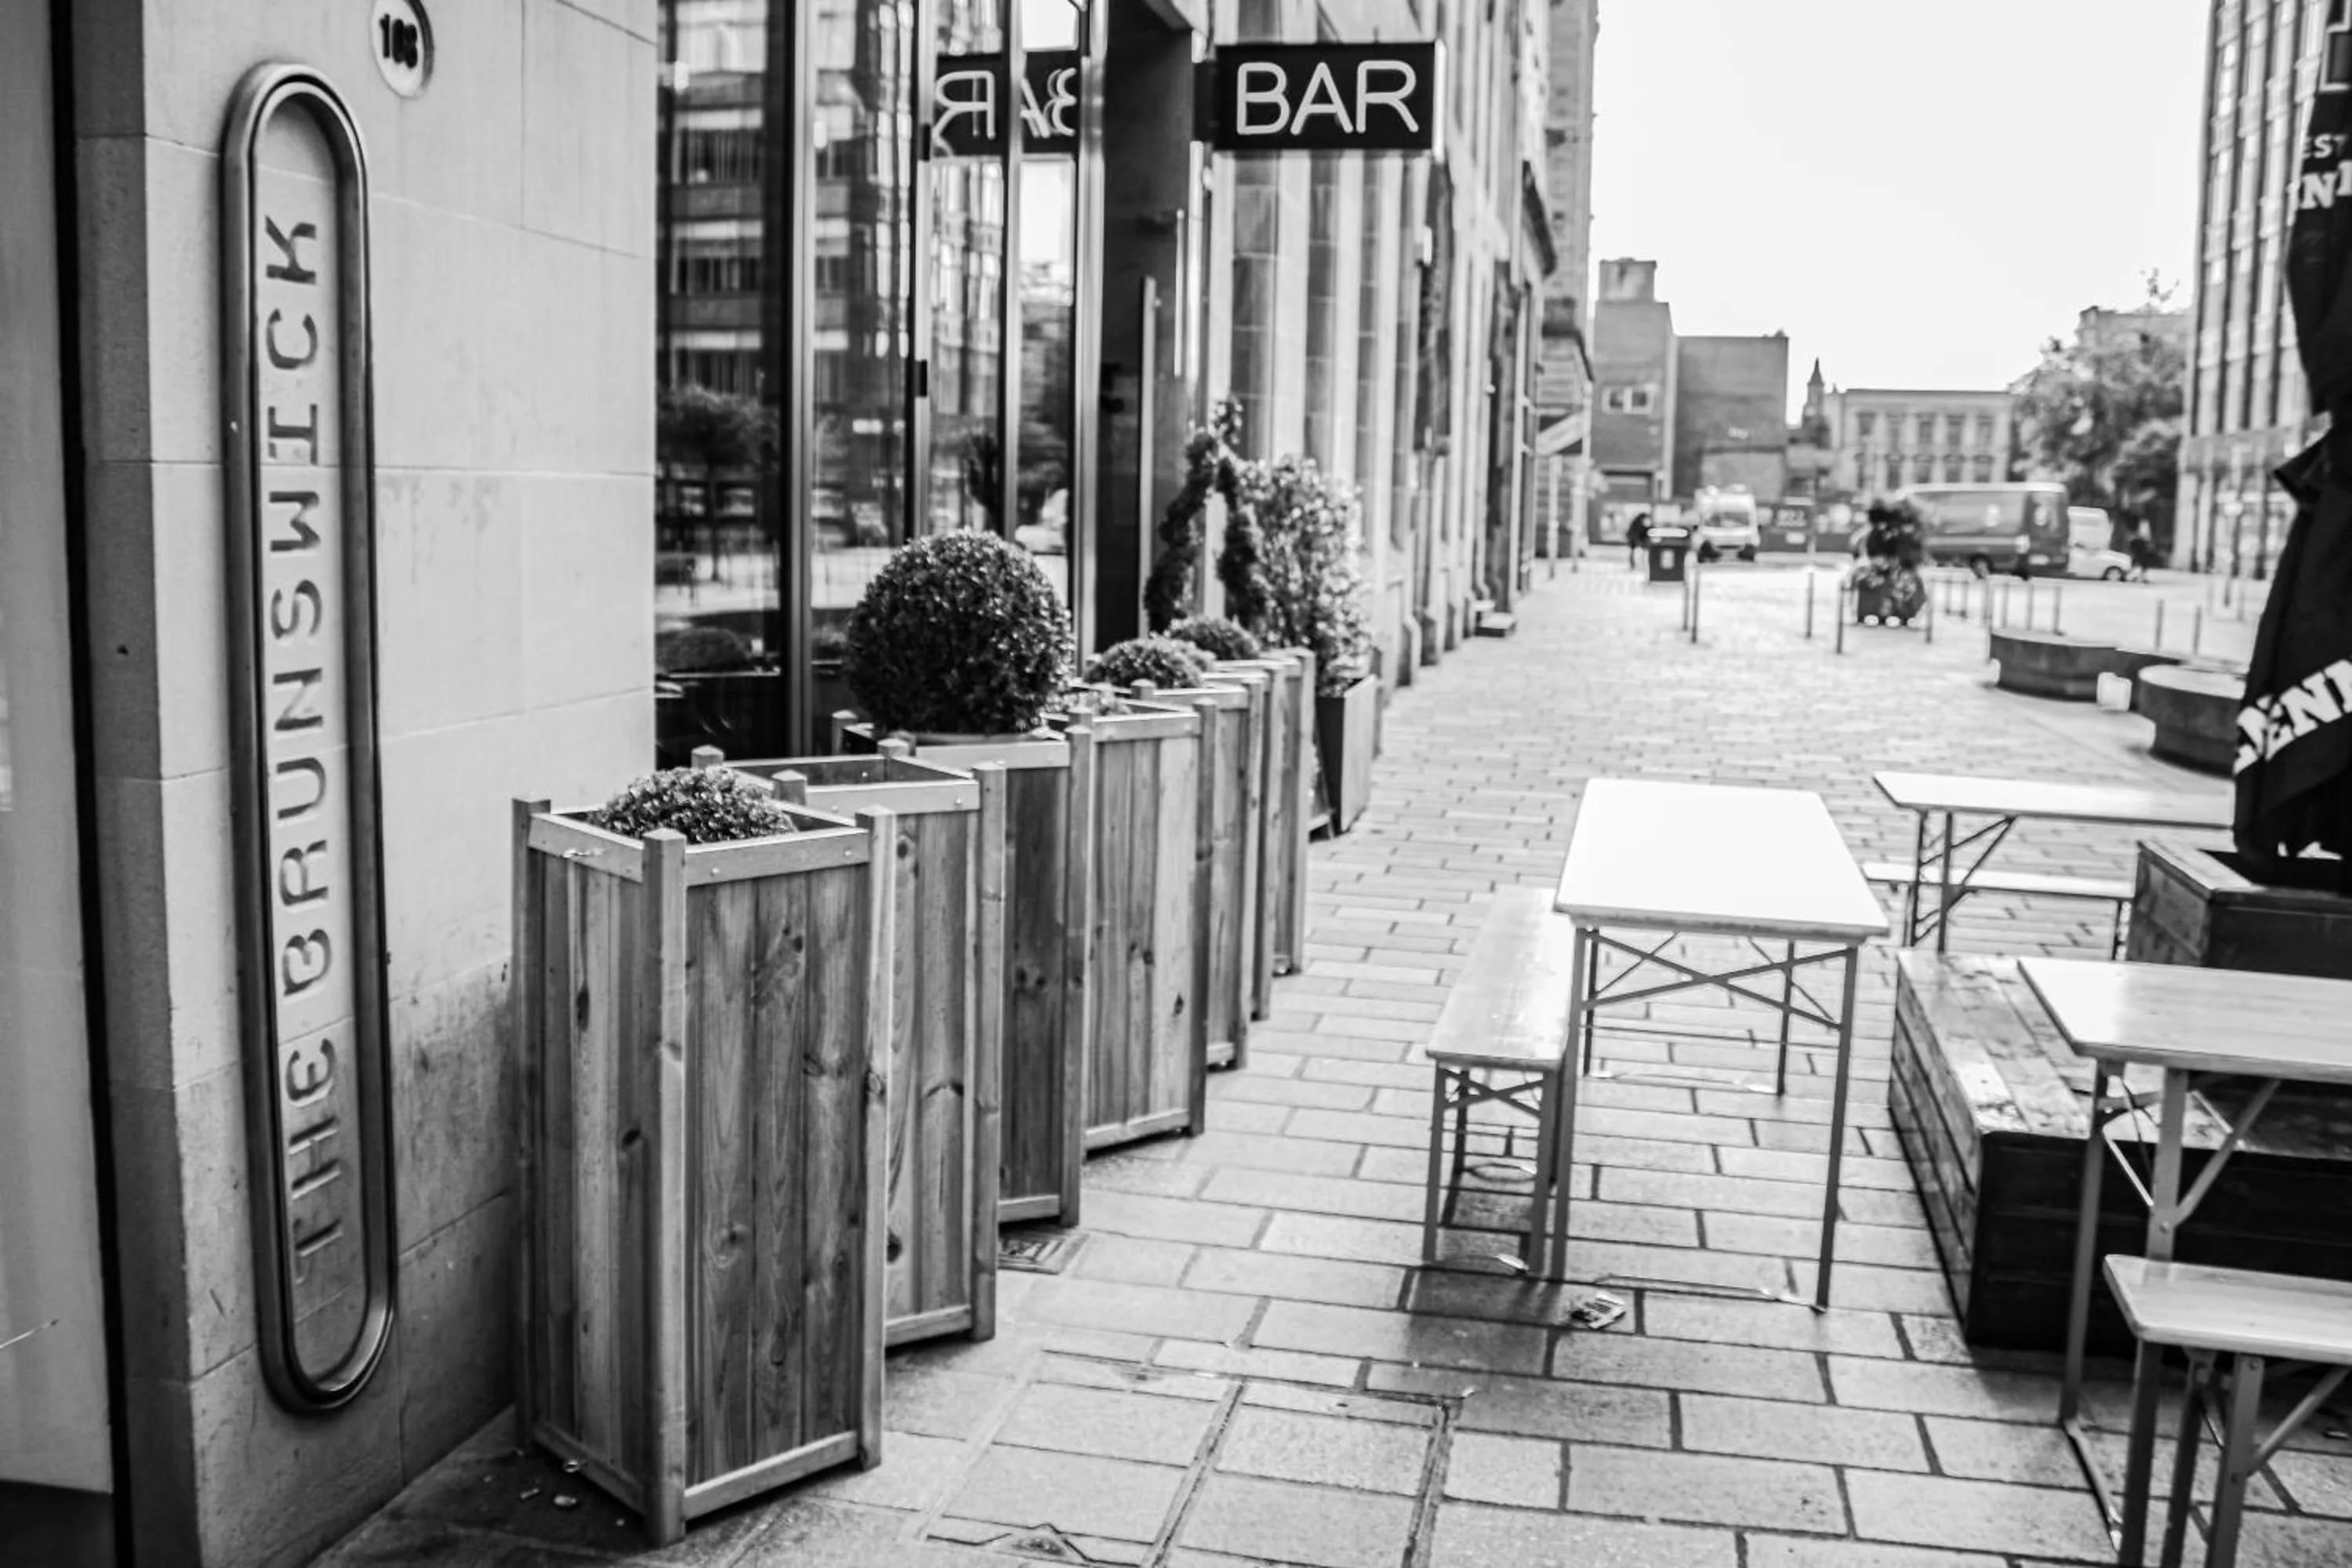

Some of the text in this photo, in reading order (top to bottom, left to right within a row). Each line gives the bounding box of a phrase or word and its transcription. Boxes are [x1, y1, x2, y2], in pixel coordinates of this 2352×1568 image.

[1236, 60, 1419, 135] BAR
[265, 214, 343, 1284] THE BRUNSWICK
